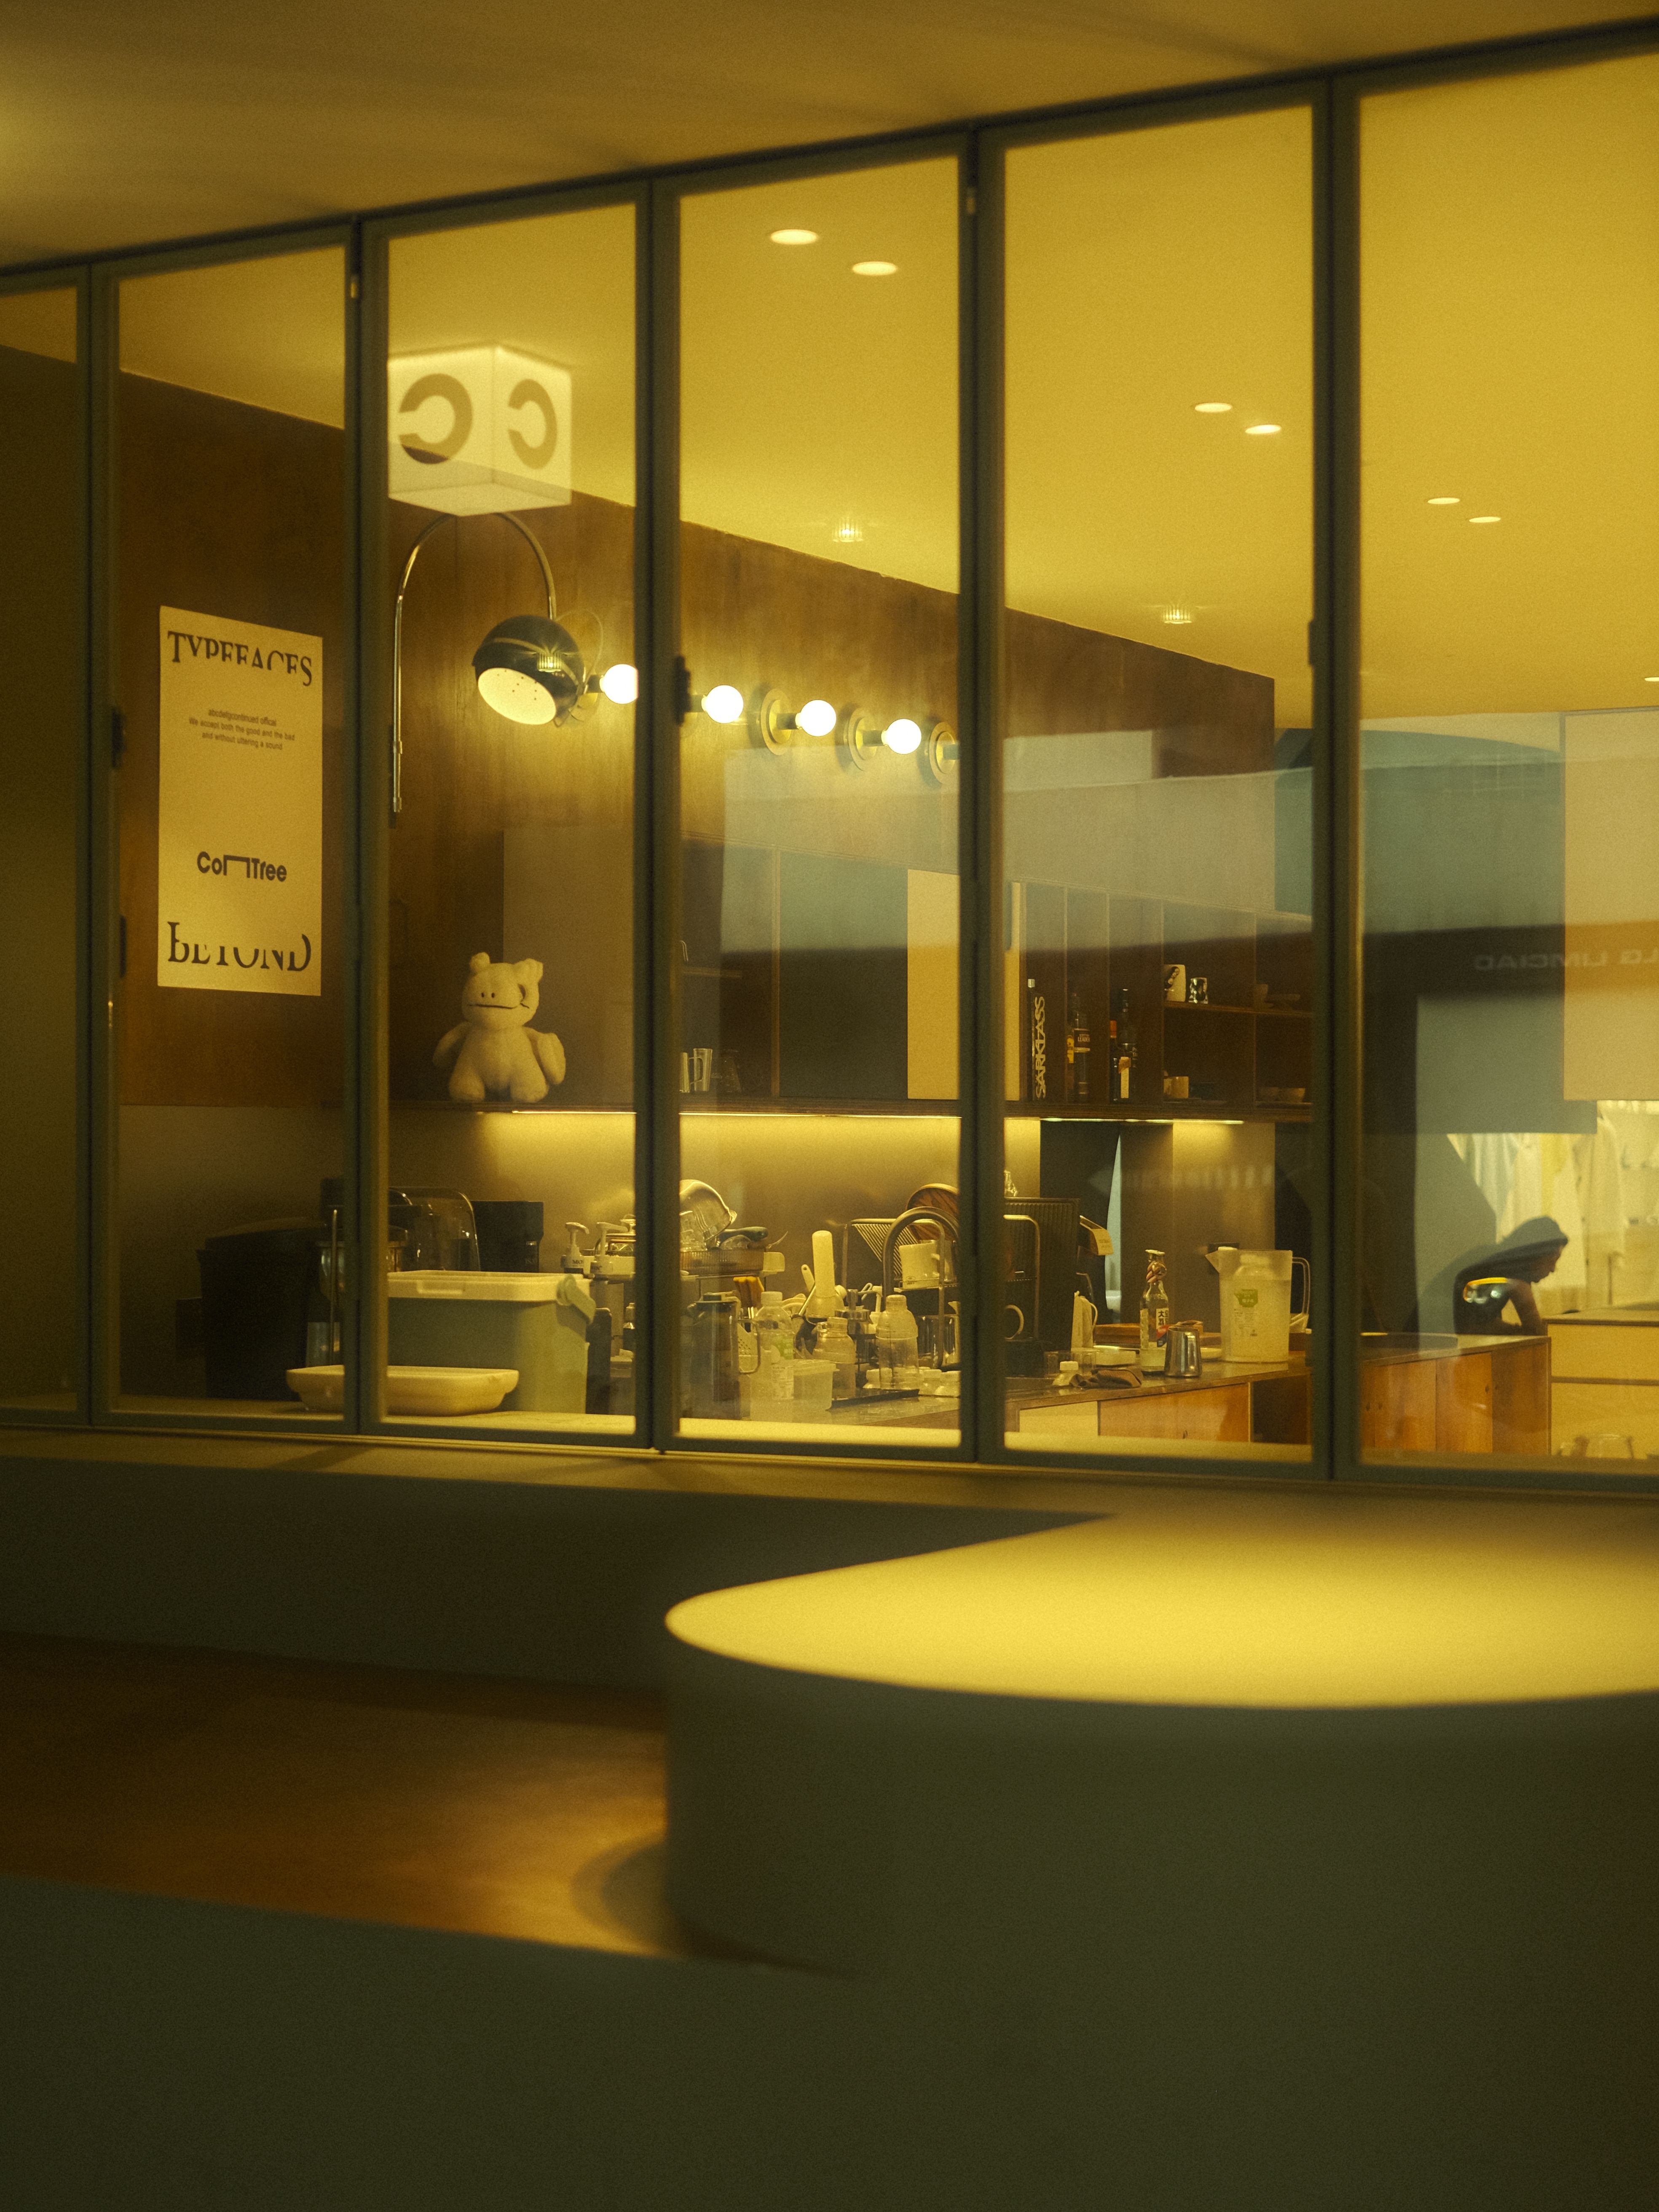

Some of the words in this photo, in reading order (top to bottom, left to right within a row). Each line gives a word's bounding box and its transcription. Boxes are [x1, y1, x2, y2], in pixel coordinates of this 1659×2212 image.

[189, 717, 198, 725] We
[201, 720, 219, 728] accept
[284, 732, 295, 741] bad
[215, 734, 235, 743] without
[237, 738, 258, 748] uttering
